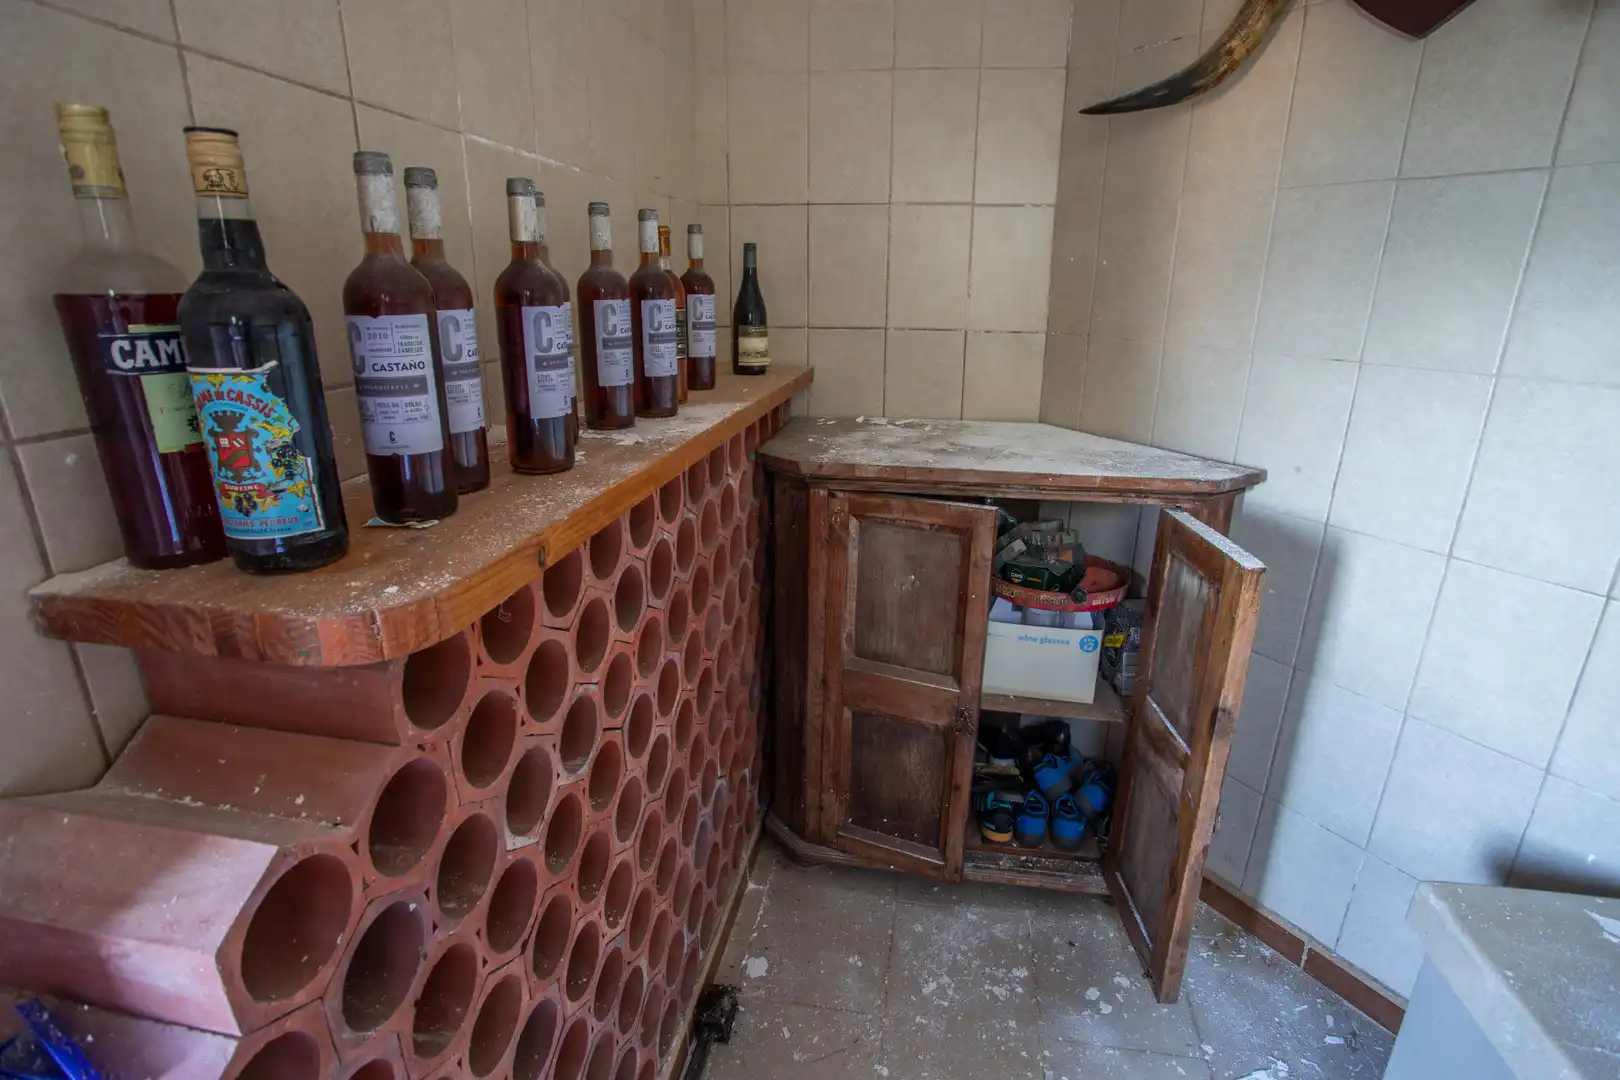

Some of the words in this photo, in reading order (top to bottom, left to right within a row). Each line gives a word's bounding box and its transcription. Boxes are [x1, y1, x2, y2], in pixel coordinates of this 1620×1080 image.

[367, 332, 389, 340] 2010
[441, 315, 463, 362] C
[533, 311, 553, 353] C
[111, 338, 191, 370] CAM
[371, 360, 426, 372] CASTAÑO
[226, 388, 277, 418] CASSIS
[1017, 633, 1038, 642] wine
[1039, 635, 1070, 645] glasses
